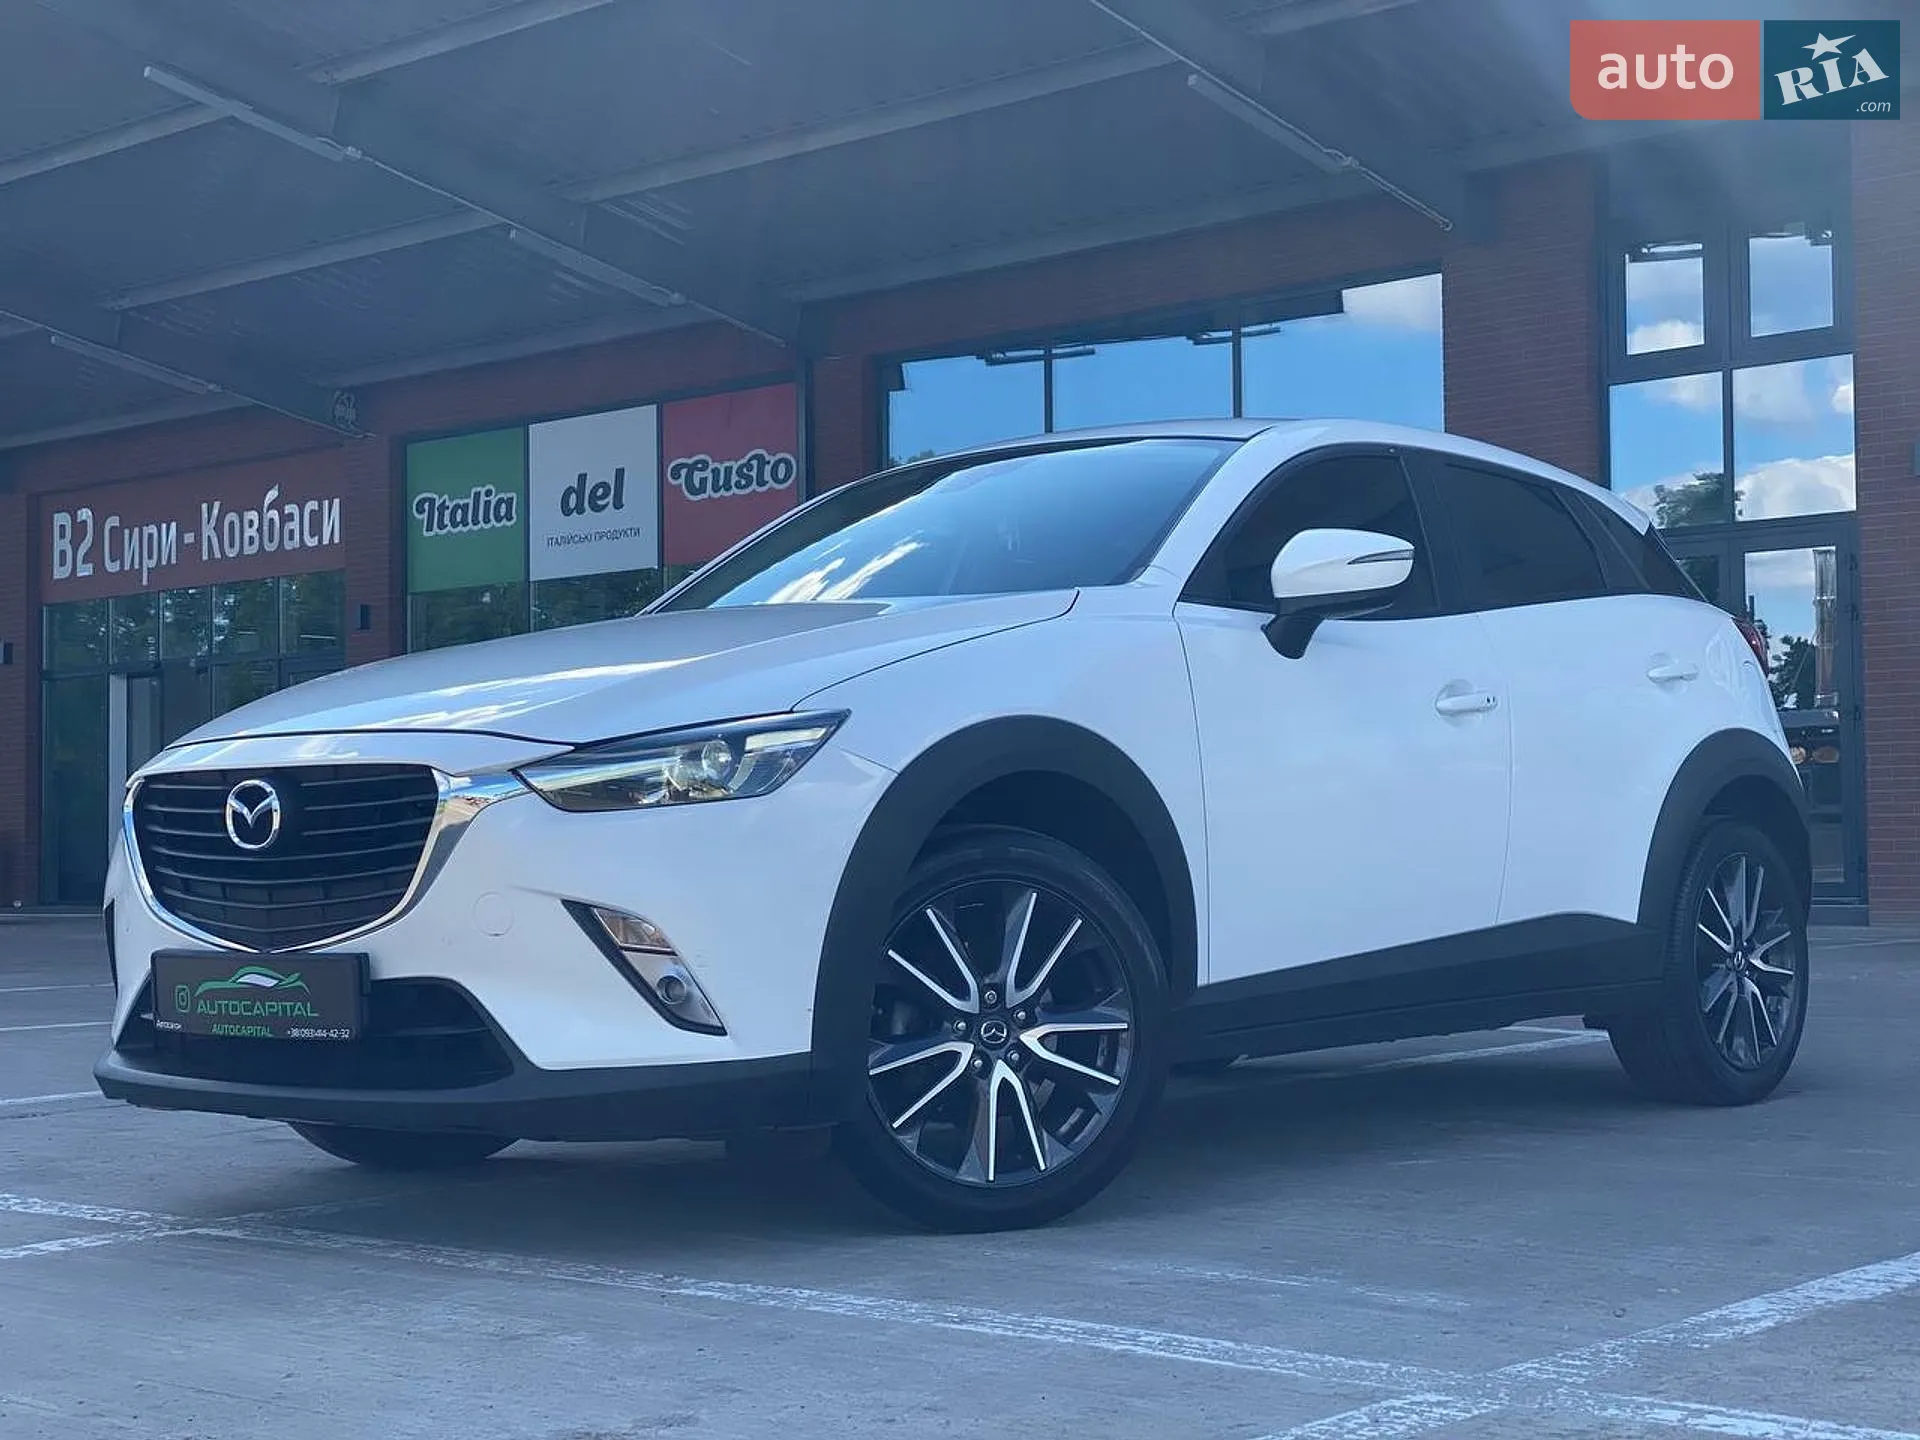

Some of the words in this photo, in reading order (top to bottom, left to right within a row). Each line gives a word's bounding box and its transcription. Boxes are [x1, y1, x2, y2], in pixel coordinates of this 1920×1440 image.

[413, 485, 518, 537] Italia
[560, 467, 626, 517] del
[668, 449, 796, 500] Gusto
[197, 1000, 320, 1017] AUTOCAPITAL
[211, 1023, 273, 1037] AUTOCAPITAL
